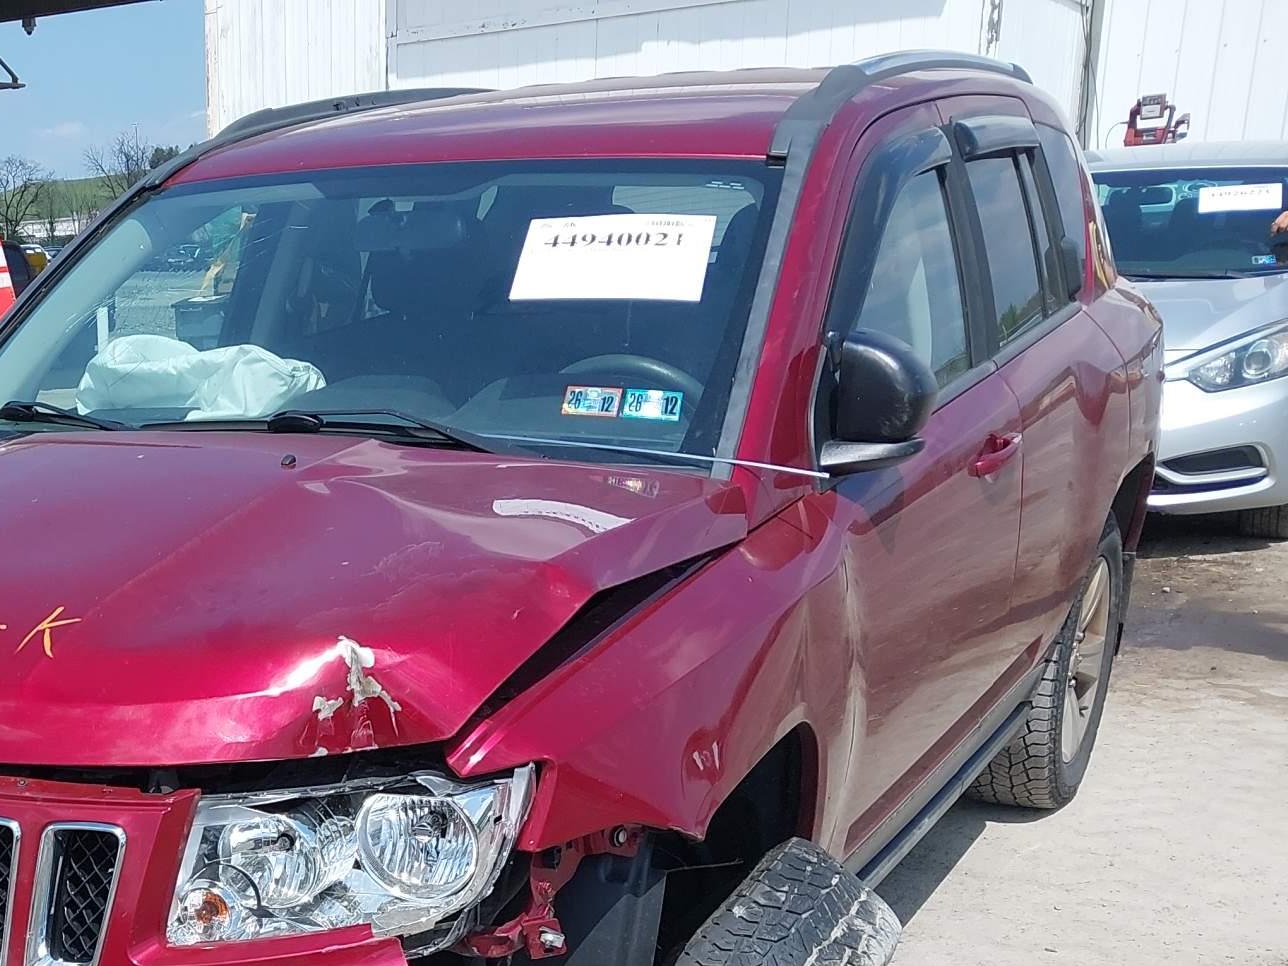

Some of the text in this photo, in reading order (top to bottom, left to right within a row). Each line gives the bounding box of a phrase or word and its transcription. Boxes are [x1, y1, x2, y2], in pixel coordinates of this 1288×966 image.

[544, 231, 683, 247] 44940021
[568, 390, 583, 410] 26
[600, 395, 614, 413] 12
[628, 392, 679, 416] 26 12
